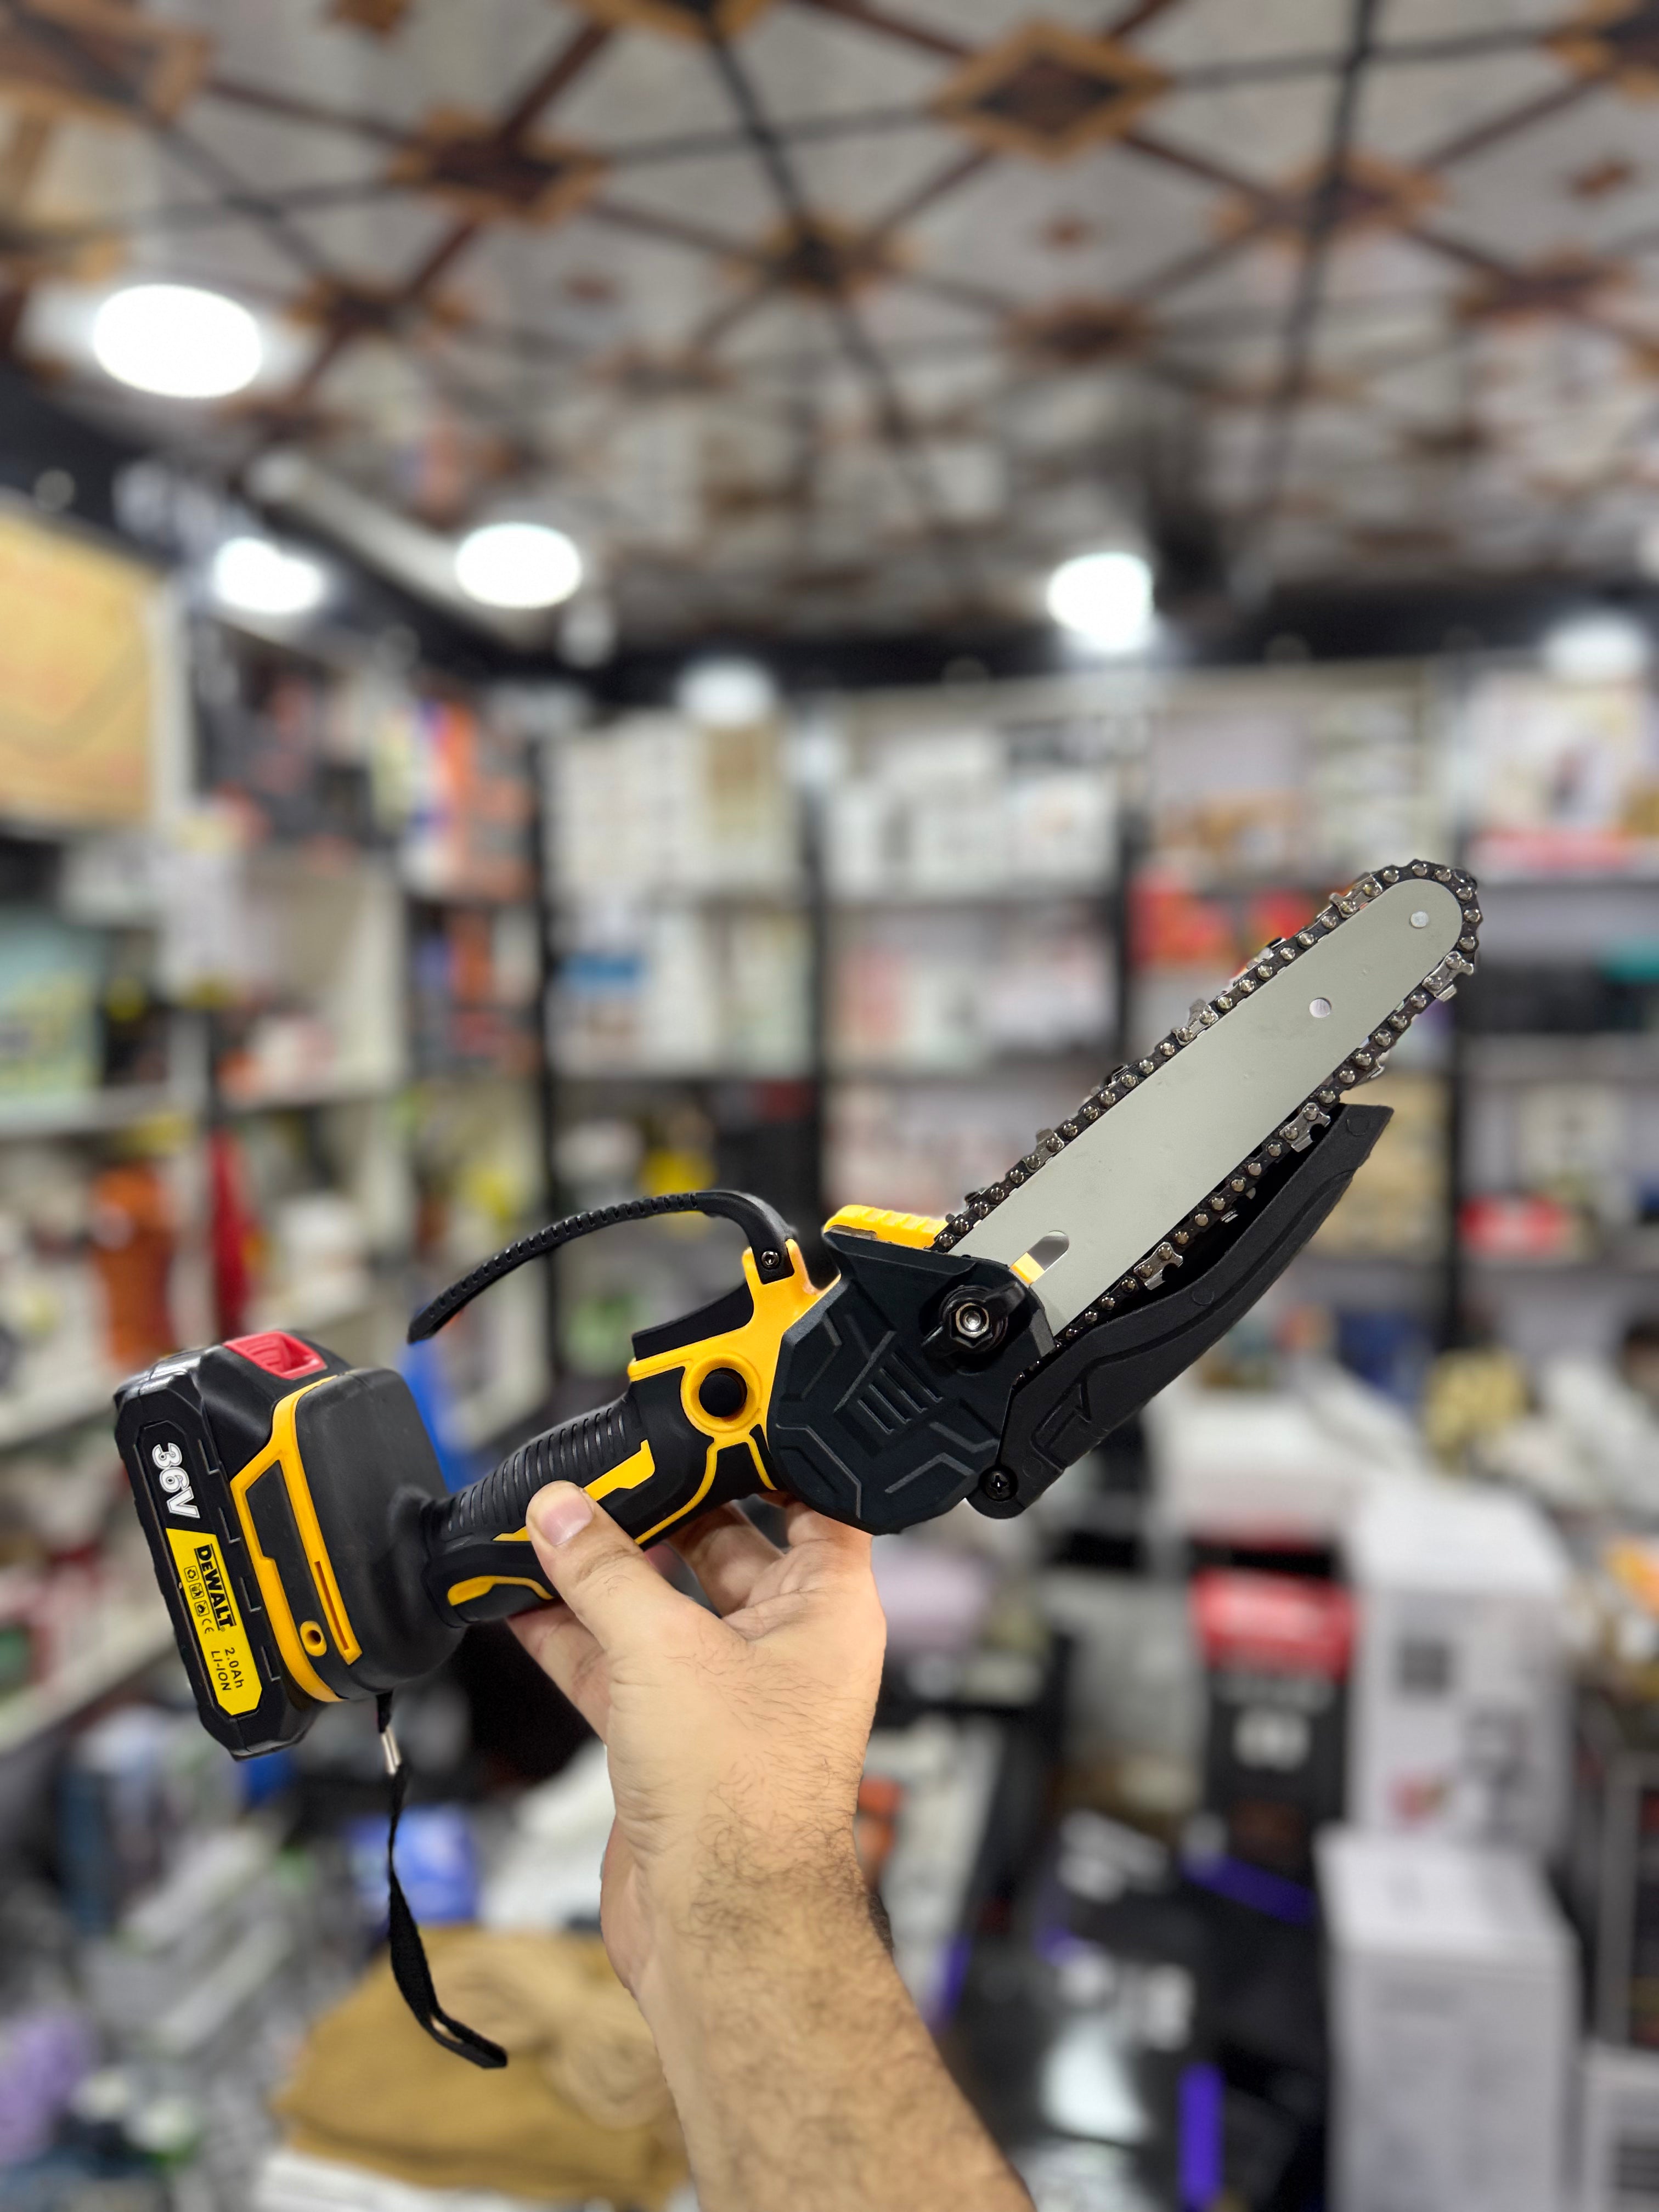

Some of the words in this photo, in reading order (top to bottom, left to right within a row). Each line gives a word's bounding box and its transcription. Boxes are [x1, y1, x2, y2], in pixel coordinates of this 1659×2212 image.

[152, 1442, 200, 1519] 36V
[195, 1544, 236, 1628] DEWALT
[211, 1651, 232, 1691] LI-ION
[225, 1647, 244, 1688] 2.0Ah
